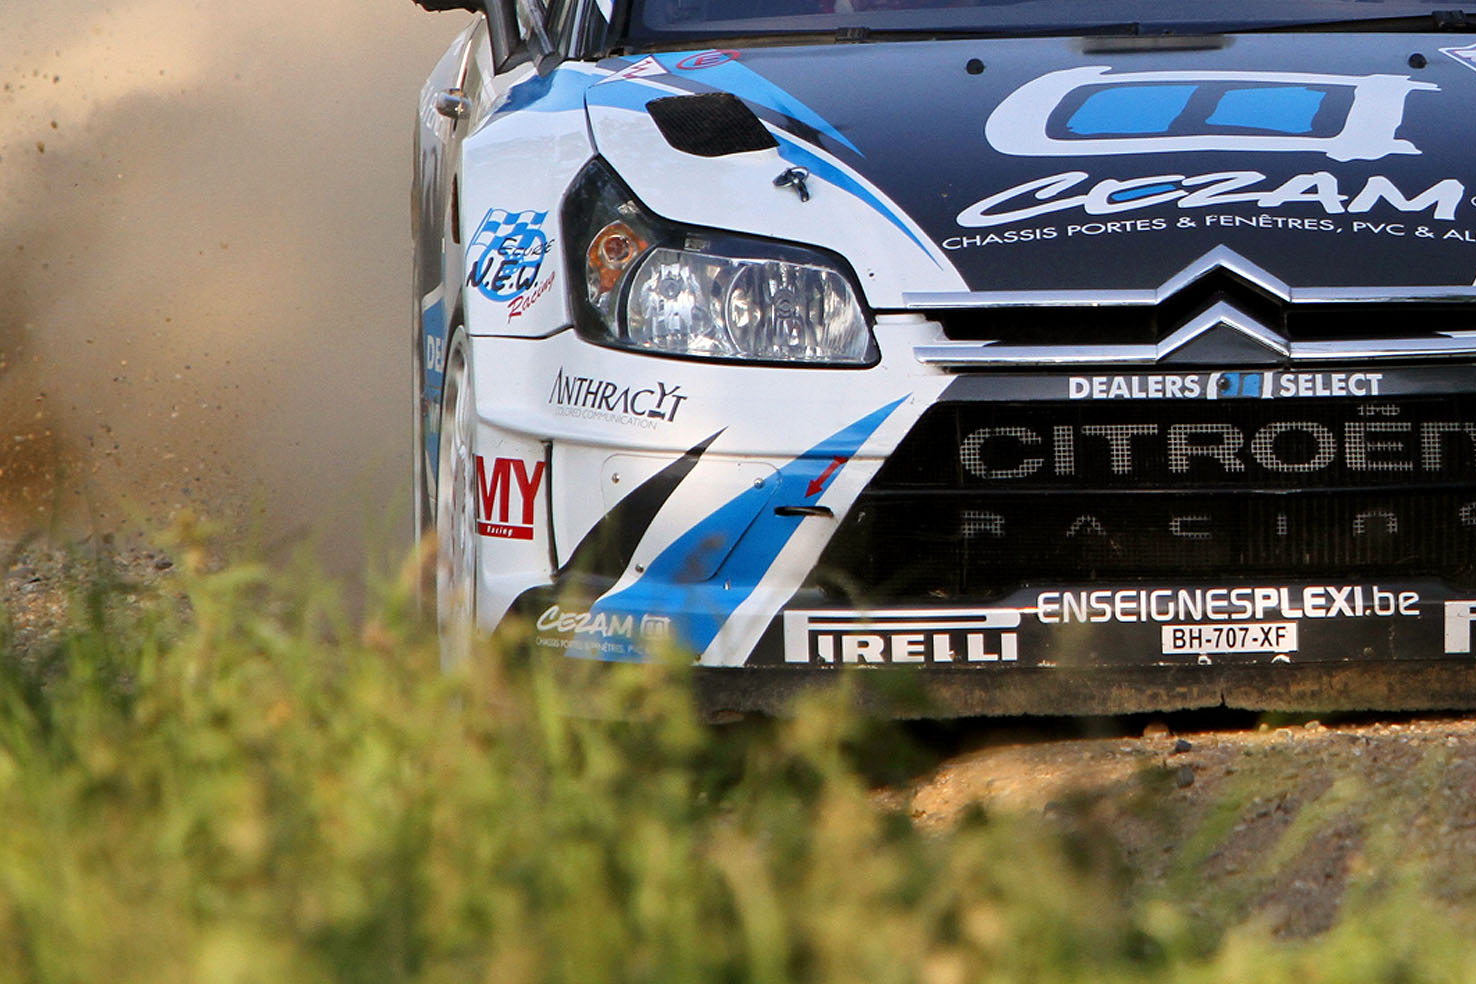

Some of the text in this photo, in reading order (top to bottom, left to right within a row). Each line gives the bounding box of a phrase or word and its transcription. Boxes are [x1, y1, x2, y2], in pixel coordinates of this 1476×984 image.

[956, 171, 1465, 228] CEZAM
[942, 225, 1058, 250] CHASSIS
[1066, 217, 1167, 236] PORTES
[1176, 216, 1198, 229] &
[1353, 221, 1405, 237] PVC
[1415, 225, 1435, 238] &
[1068, 373, 1383, 400] DEALERS SELECT
[475, 455, 546, 525] MY
[1037, 585, 1420, 624] ENSEIGNESPLEXI.be
[784, 609, 1021, 664] PIRELLI
[1173, 625, 1286, 650] BH-707-XF
